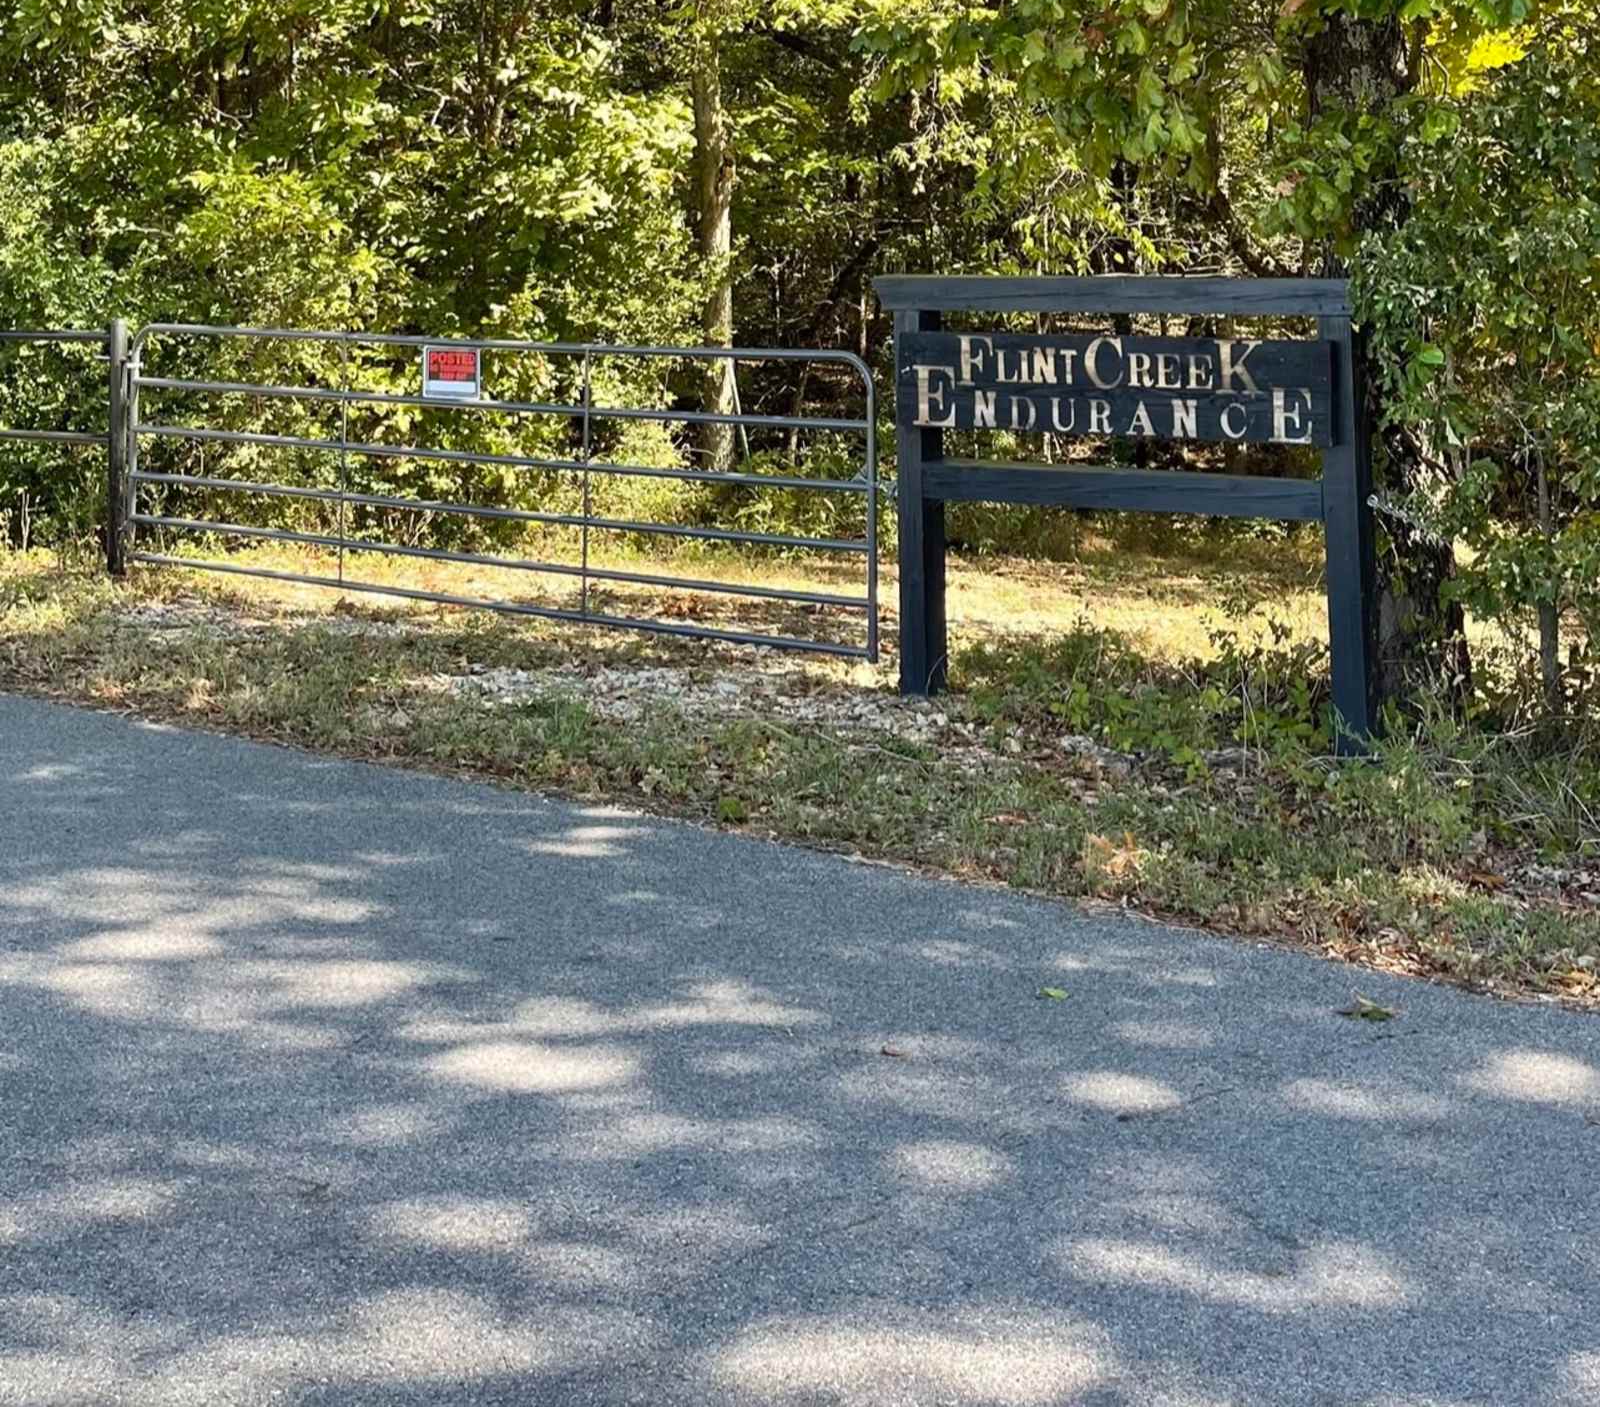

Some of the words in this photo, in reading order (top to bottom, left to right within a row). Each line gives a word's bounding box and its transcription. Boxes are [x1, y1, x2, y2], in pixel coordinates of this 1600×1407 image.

[431, 352, 475, 365] POSTED
[956, 335, 1077, 386] FLINT
[1084, 336, 1263, 395] CREEK
[912, 364, 1312, 445] ENDURANCE
